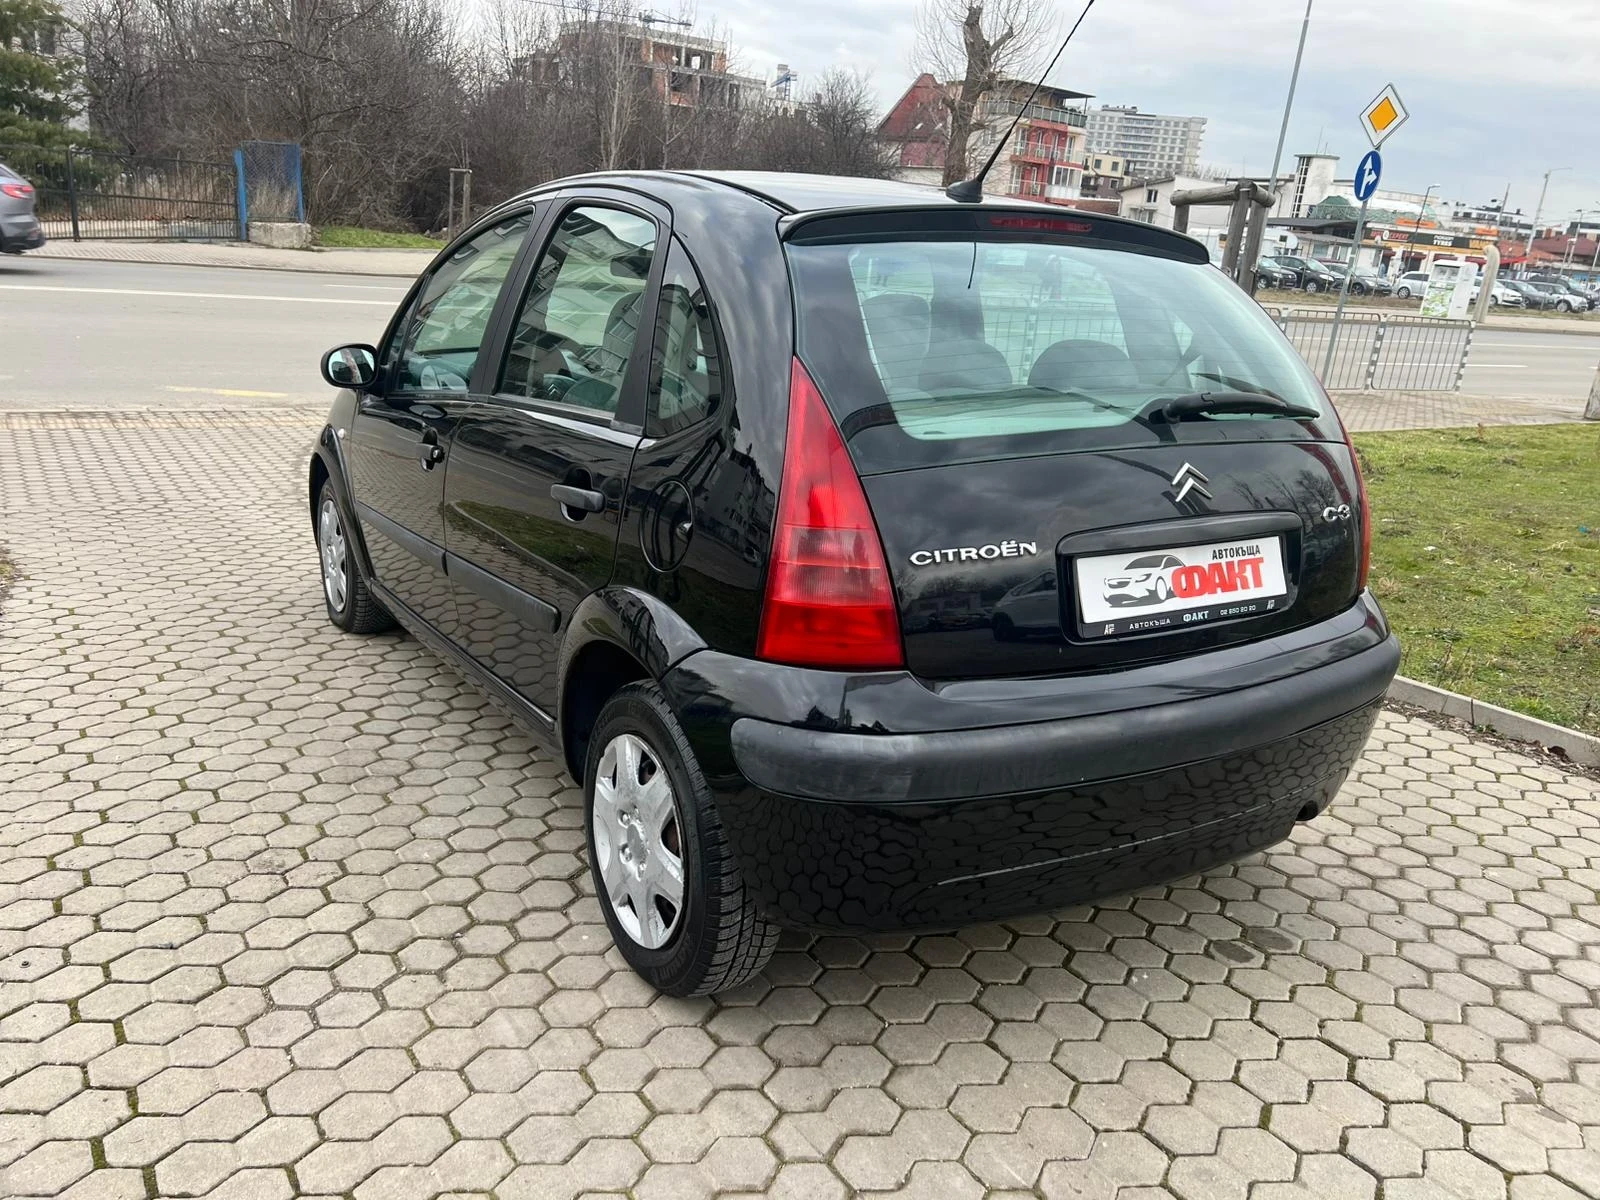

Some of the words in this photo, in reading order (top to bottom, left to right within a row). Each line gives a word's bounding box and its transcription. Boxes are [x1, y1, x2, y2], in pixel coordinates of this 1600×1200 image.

[909, 540, 1037, 566] CITROËN
[1211, 544, 1262, 561] АВТОКЪЩА
[1171, 557, 1264, 599] ФАКТ
[1183, 610, 1209, 622] ФАКТ
